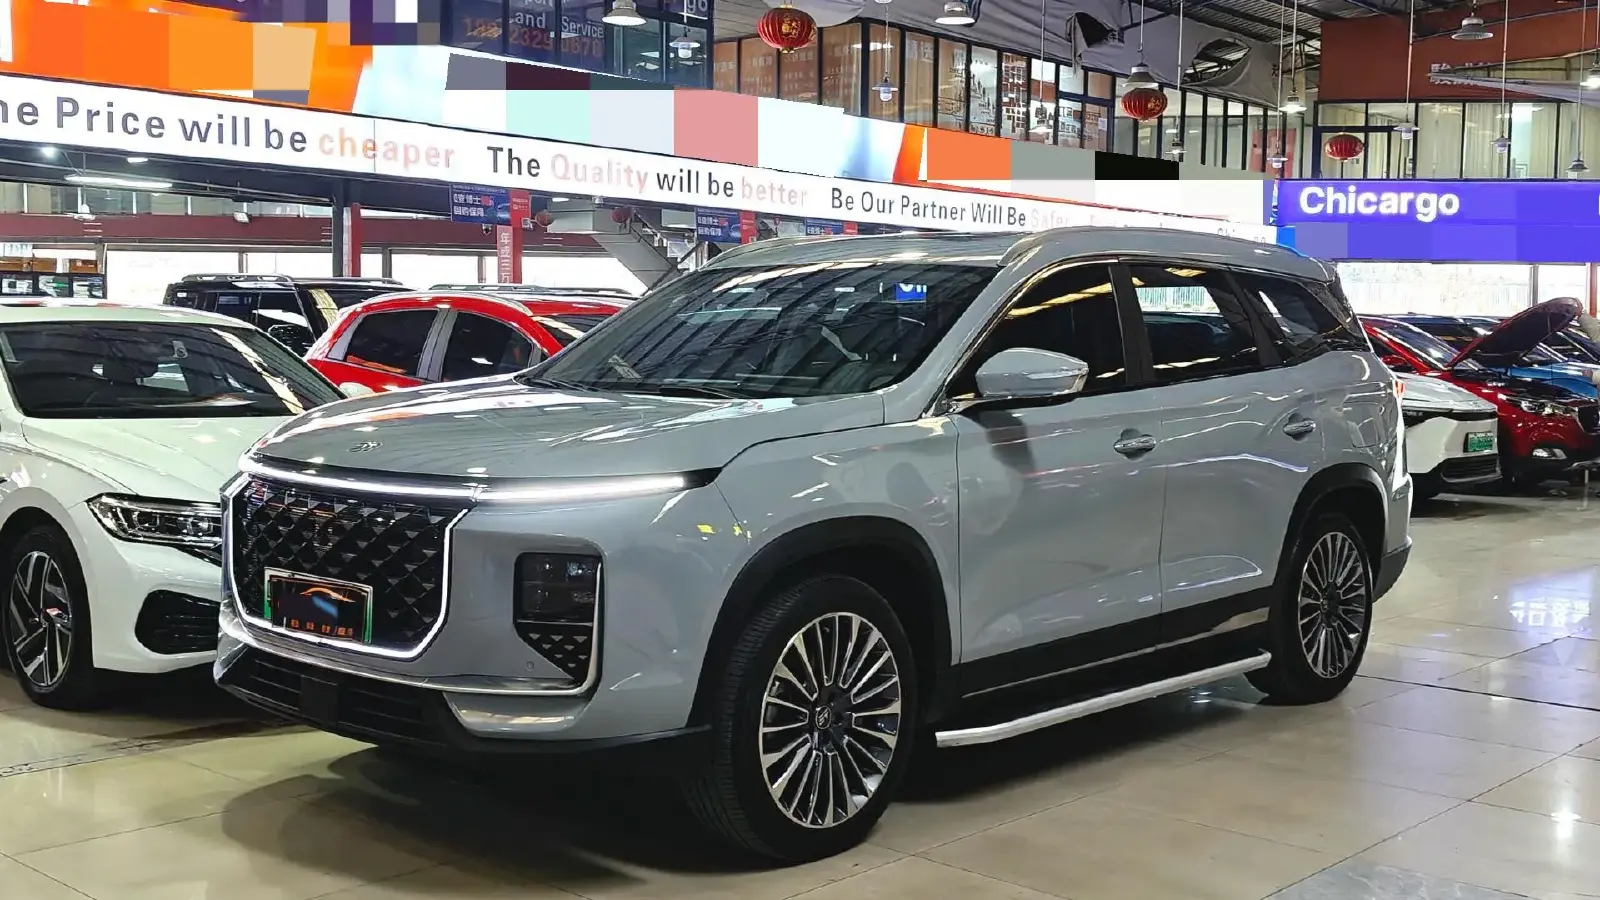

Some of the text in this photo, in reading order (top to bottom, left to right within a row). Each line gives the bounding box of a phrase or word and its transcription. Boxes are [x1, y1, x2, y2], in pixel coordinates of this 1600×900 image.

[515, 12, 546, 29] and
[561, 16, 605, 38] Service
[56, 96, 165, 138] Price
[178, 113, 251, 148] will
[264, 118, 307, 153] be
[318, 127, 455, 170] cheaper
[486, 145, 808, 207] The Quality will be better
[831, 187, 855, 211] Be
[861, 191, 895, 214] Our
[901, 194, 966, 221] Partner
[972, 201, 1003, 225] Will
[1007, 206, 1027, 227] Be
[1298, 184, 1461, 223] Chicargo
